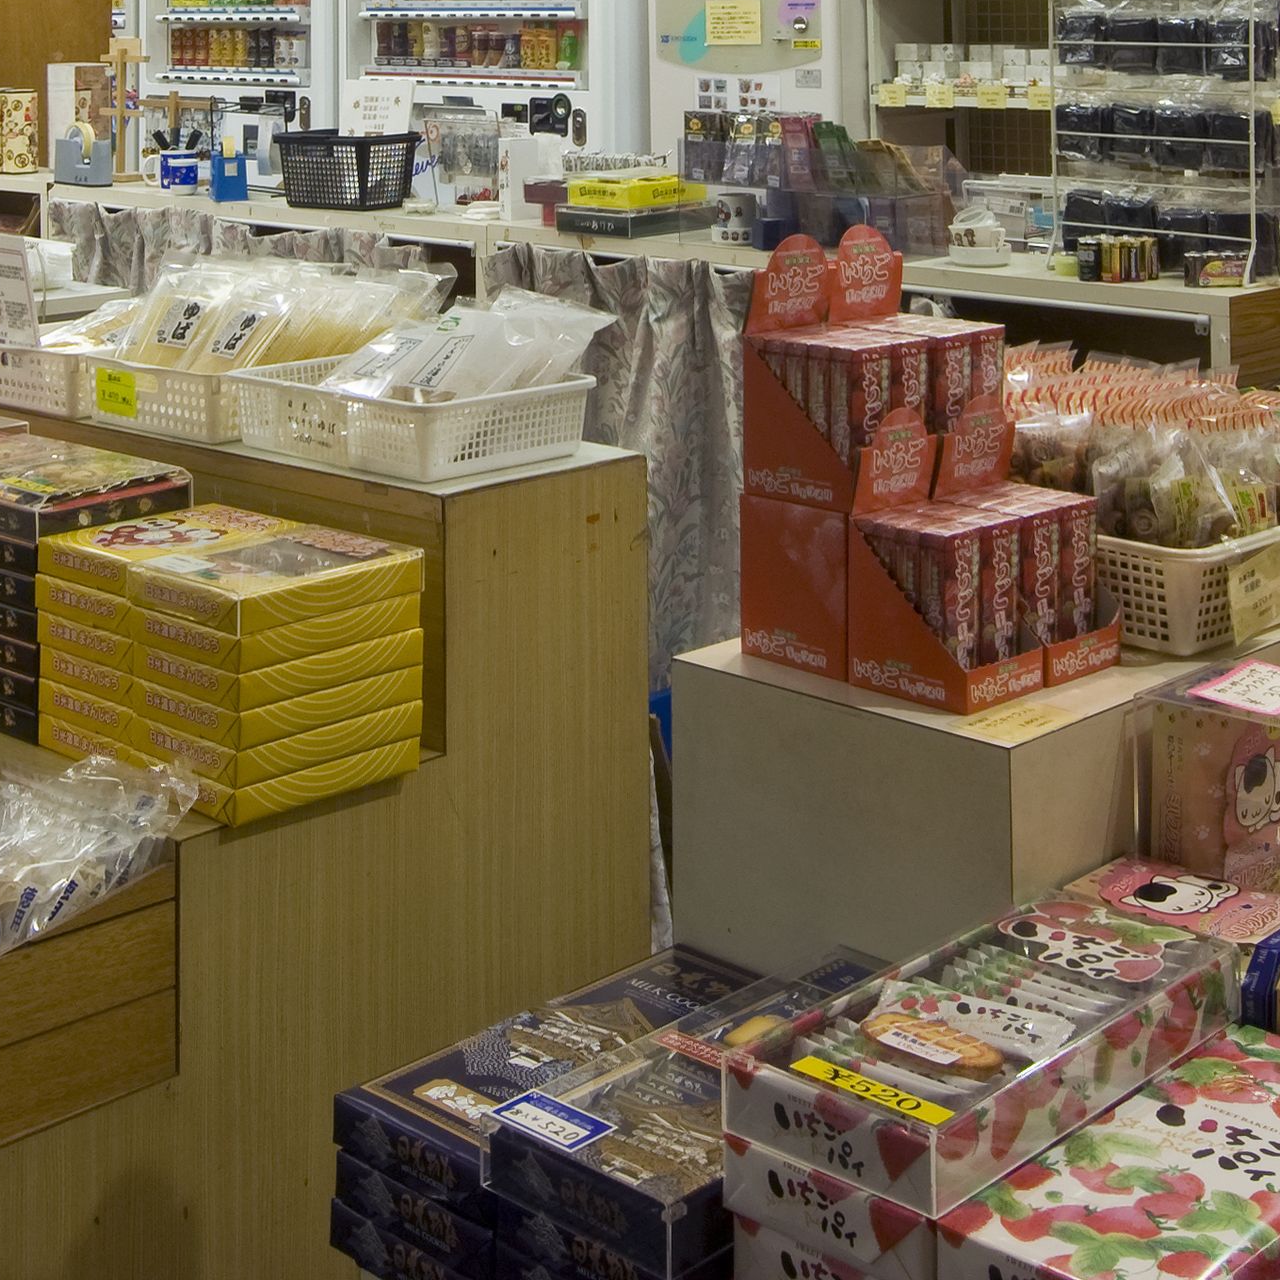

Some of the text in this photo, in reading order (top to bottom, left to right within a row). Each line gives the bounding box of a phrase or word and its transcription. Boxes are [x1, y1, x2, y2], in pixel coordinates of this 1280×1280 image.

[768, 263, 824, 298] いちご
[839, 254, 891, 285] いちご
[171, 302, 201, 341] ゆば
[224, 314, 256, 350] ゆば
[873, 439, 925, 475] いちご
[954, 425, 1005, 459] いちご
[748, 469, 791, 494] いちご
[744, 628, 786, 656] いちご
[853, 657, 899, 688] いちご
[1052, 649, 1089, 677] いちご
[970, 673, 1009, 704] いちご
[1011, 920, 1157, 960] いちご
[1043, 951, 1118, 978] パイ
[628, 977, 663, 1001] MILK
[956, 1001, 1036, 1030] いちご
[824, 1066, 923, 1112] ¥520
[774, 1102, 842, 1141] いちご
[1204, 1103, 1243, 1121] SWEET
[1243, 1116, 1280, 1135] BAKED
[828, 1141, 864, 1178] パイ
[1192, 1147, 1277, 1181] パイ
[768, 1169, 835, 1210] いちご
[821, 1211, 857, 1248] パイ
